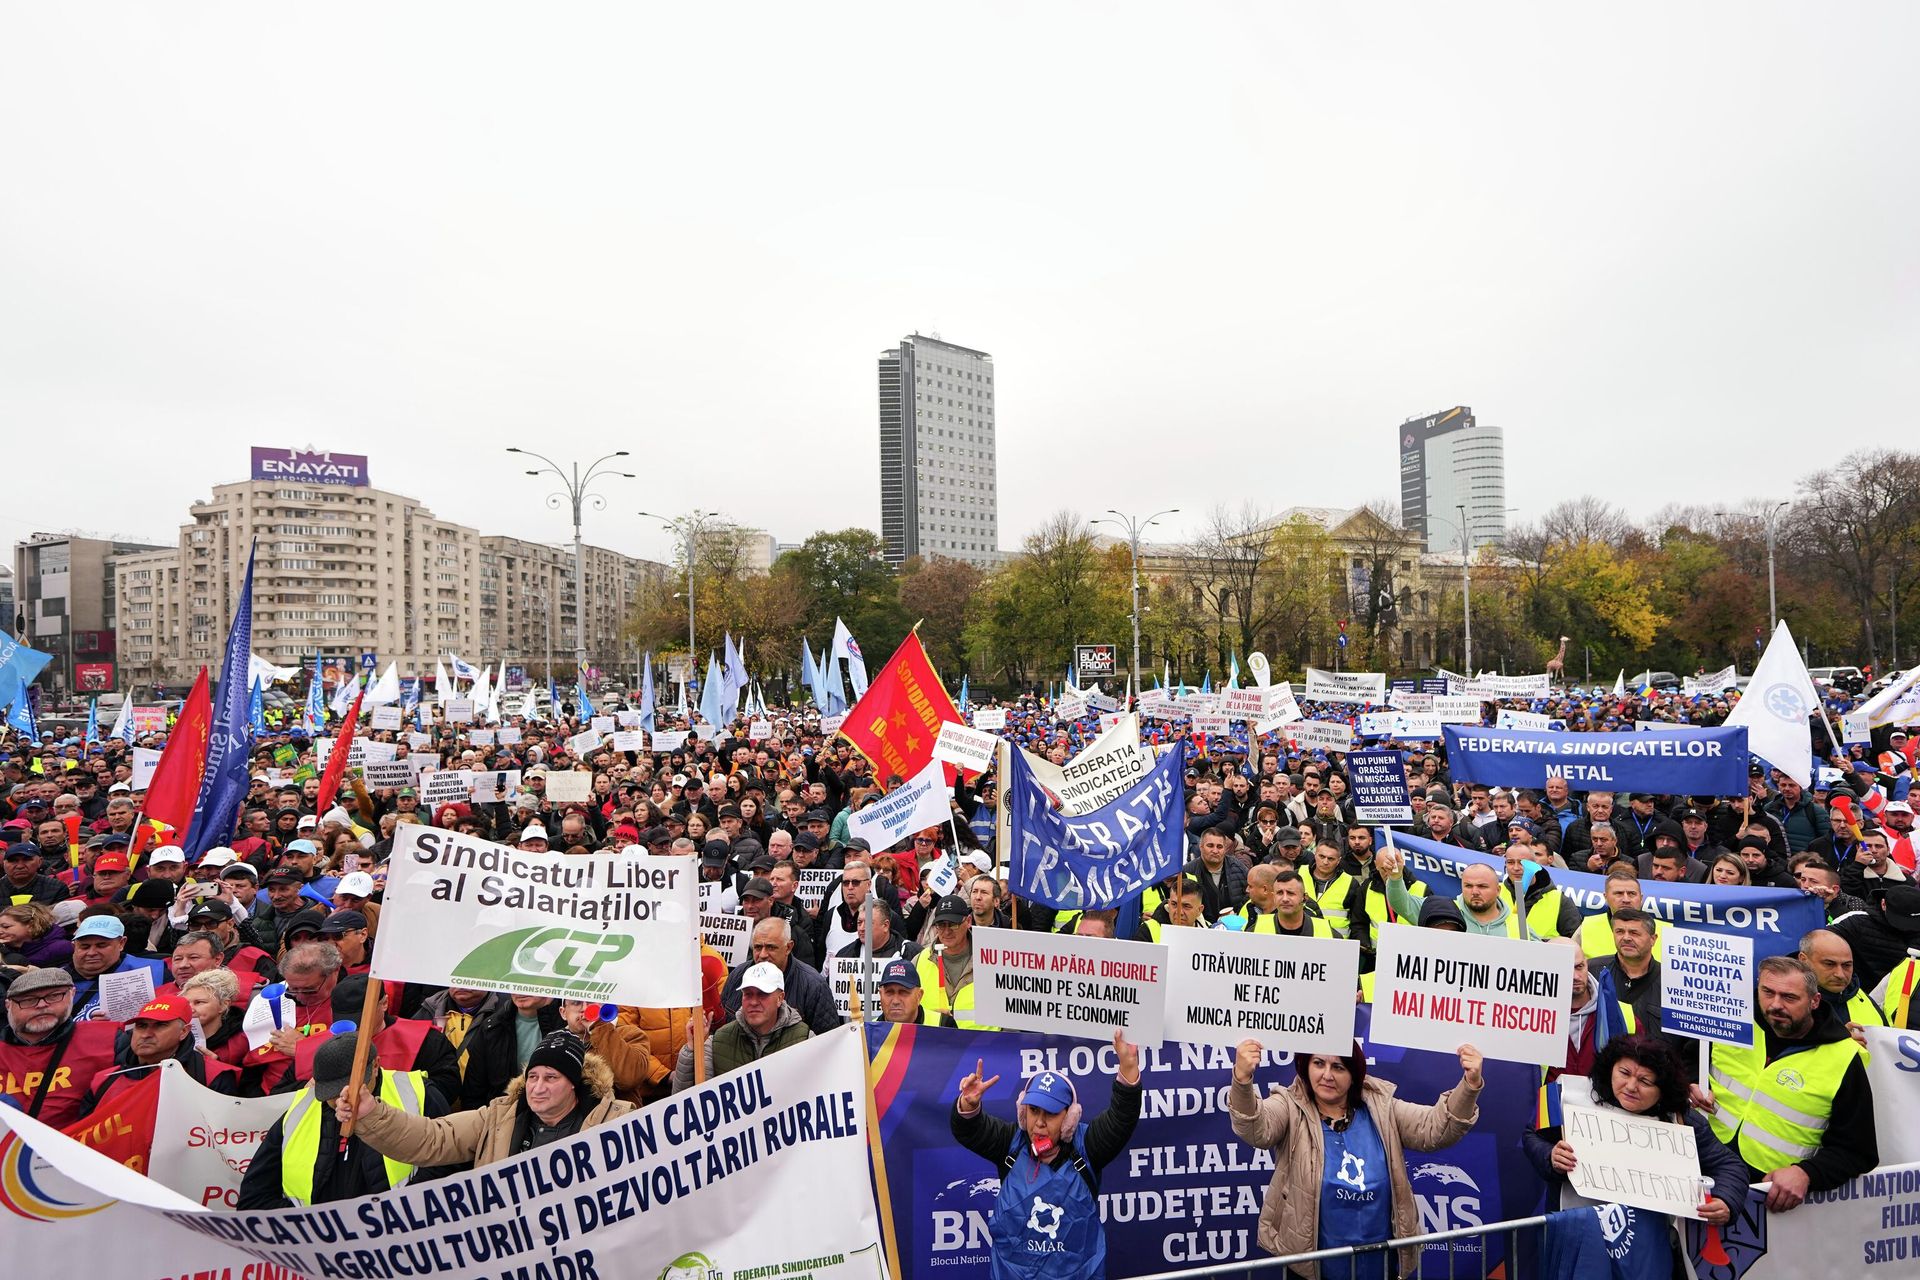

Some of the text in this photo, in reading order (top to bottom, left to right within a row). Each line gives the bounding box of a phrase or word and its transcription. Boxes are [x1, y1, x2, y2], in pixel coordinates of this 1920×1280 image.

[1425, 418, 1437, 429] EY
[262, 459, 358, 478] ENAYATI
[274, 475, 320, 484] MEDICAL
[1080, 652, 1111, 662] BLACK
[1080, 661, 1111, 670] FRIDAY
[897, 659, 942, 739] SOLIDARIT
[1411, 719, 1438, 727] SMAR
[1517, 719, 1546, 729] SMAR
[942, 729, 963, 742] VENITURI
[1458, 737, 1722, 757] FEDERATIA SINDICATELOR
[1352, 756, 1397, 765] NOI PUNEM
[1358, 765, 1390, 775] ORAȘUL
[1061, 760, 1141, 800] SINDICATELO
[1354, 773, 1401, 784] ÎN MIȘCARE
[1546, 764, 1613, 781] METAL
[1355, 786, 1404, 795] VOI BLOCAȚI
[1359, 795, 1403, 804] SALARIILE!
[1072, 798, 1094, 815] DIN
[412, 833, 680, 891] Sindicatul Liber
[800, 885, 828, 895] PENTR
[430, 873, 467, 903] al
[477, 875, 662, 930] Salariaților
[704, 931, 735, 947] XĂRII
[1683, 935, 1731, 951] ORAȘUL
[1668, 944, 1746, 966] E ÎN MIȘCARE
[837, 959, 859, 974] FĂRĂ
[979, 947, 1158, 983] NU PUTEM APĂRA DIGURILE
[1191, 951, 1327, 982] OTRĂVURILE DIN APE
[1671, 958, 1743, 981] DATORITA
[1394, 952, 1559, 998] MAI PUȚINI OAMENI
[451, 977, 498, 990] COMPANIA
[499, 982, 511, 990] DE
[512, 983, 562, 996] TRANSPORT
[563, 988, 592, 1000] PUBLIC
[995, 972, 1141, 1005] MUNCIND PE SALARIUL
[1234, 983, 1280, 1005] NE FAC
[1683, 975, 1731, 995] NOUĂ!
[1666, 986, 1748, 1009] VREM DREPTATE,
[1670, 996, 1683, 1006] NU
[144, 1003, 170, 1013] SLPR
[1005, 996, 1130, 1027] MINIM PE ECONOMIE
[1392, 989, 1557, 1036] MAI MULTE RISCURI
[1186, 1005, 1325, 1035] MUNCA PERICULOASĂ
[1719, 1021, 1742, 1031] LIBER
[1679, 1021, 1735, 1039] TRANSURBAN
[1610, 1119, 1697, 1160] DISTRUS
[162, 1068, 772, 1245] SINDICATUL SALARIAȚILOR DIN CADRUL
[315, 1211, 535, 1280] AGRICULTURII
[540, 1206, 571, 1244] ȘI
[577, 1127, 759, 1235] DEZVOLTĂRII
[766, 1091, 858, 1152] RURALE
[1336, 1189, 1374, 1203] SMAR
[1414, 1194, 1484, 1239] NS
[931, 1210, 993, 1252] BN
[1027, 1239, 1065, 1253] SMAR
[1162, 1228, 1249, 1263] CLUJ
[1425, 1243, 1448, 1252] ional
[1864, 1237, 1907, 1265] SATU
[733, 1264, 781, 1280] FEDERAȚIA
[782, 1253, 845, 1275] SINDICATELOR
[930, 1253, 990, 1267] Blocul Națion
